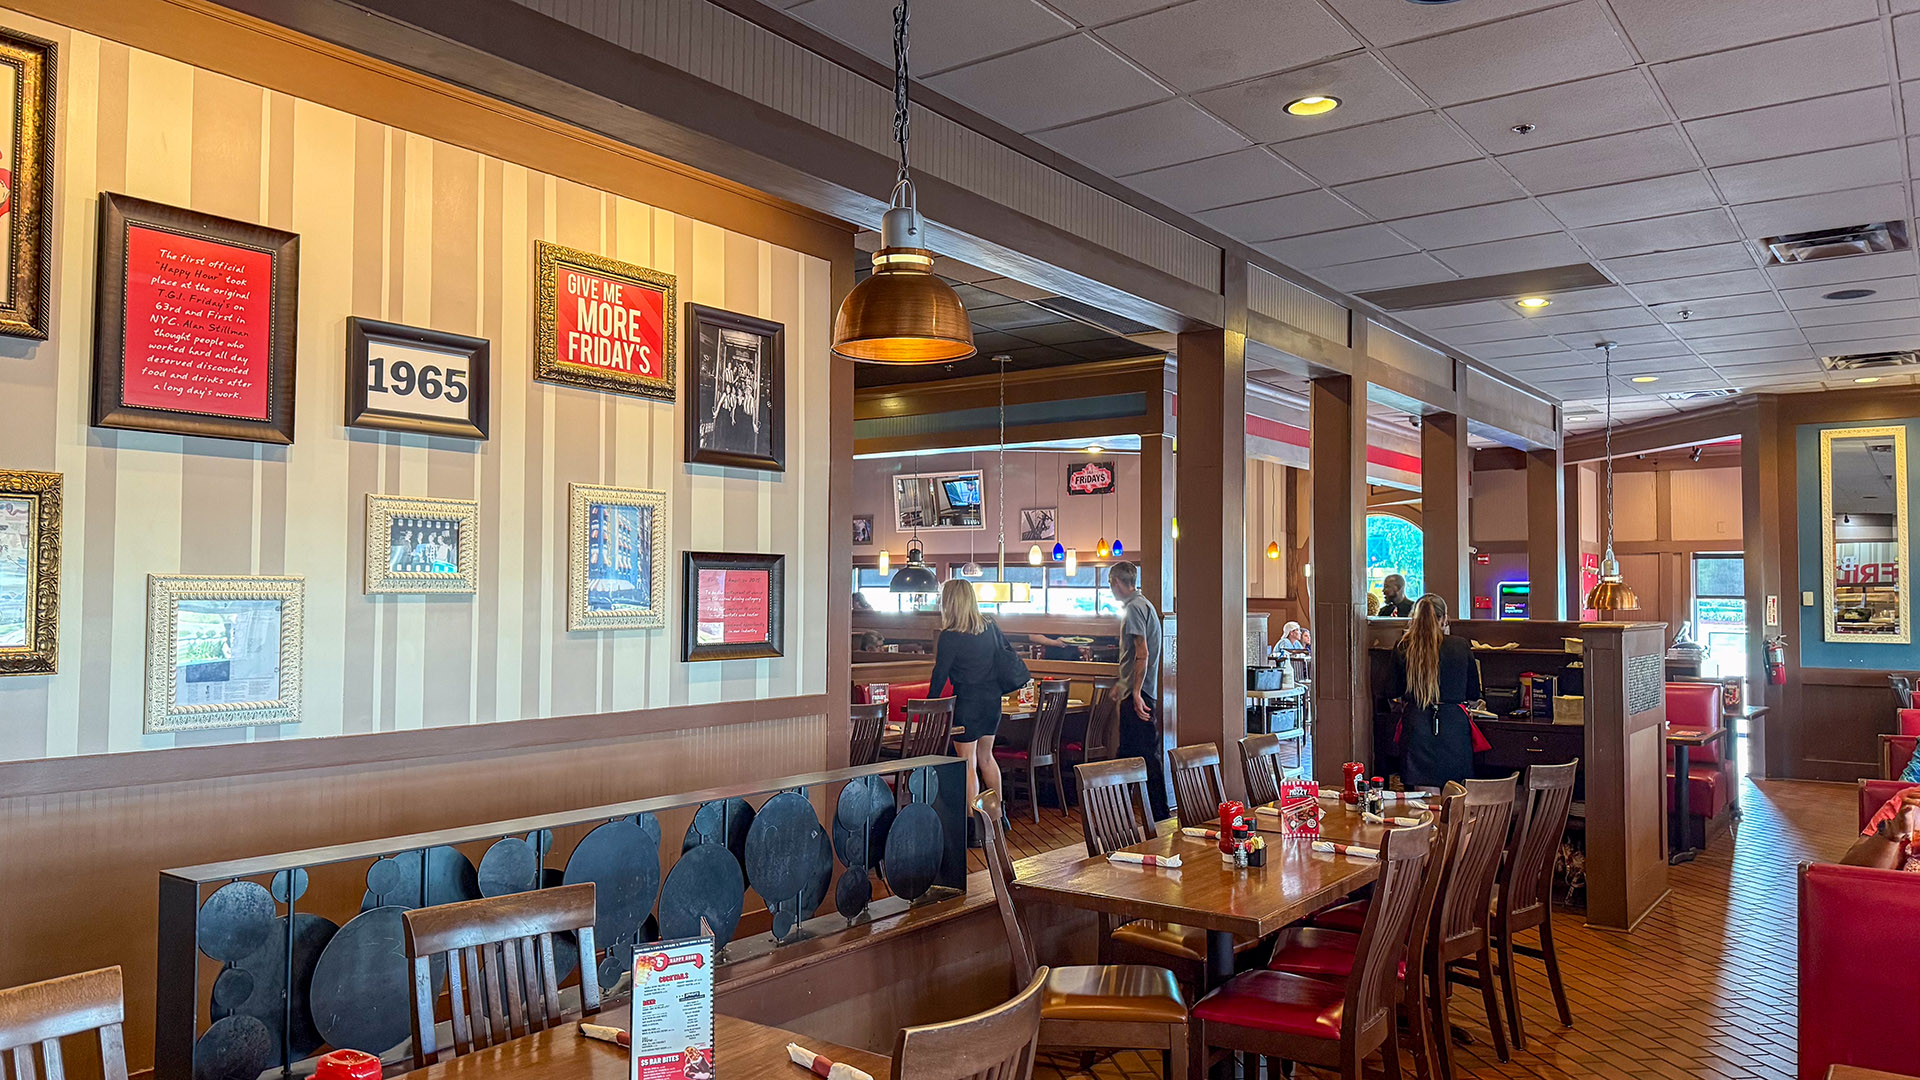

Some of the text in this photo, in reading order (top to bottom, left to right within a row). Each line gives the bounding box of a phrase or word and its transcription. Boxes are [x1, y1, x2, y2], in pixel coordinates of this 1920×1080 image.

[160, 249, 245, 273] The first official
[156, 261, 247, 286] "Happy Hour" took
[151, 276, 250, 300] place at the original
[158, 288, 185, 300] T.G.I.
[189, 295, 230, 310] Friday's
[568, 274, 623, 305] GIVE ME
[155, 302, 245, 324] 63rd and First in
[578, 297, 641, 343] MORE
[150, 314, 249, 336] NYC. Alan Stillman
[154, 328, 244, 349] thought people who
[147, 355, 249, 375] deserved discounted
[149, 343, 248, 366] worked hard all day
[142, 367, 166, 377] food
[192, 374, 224, 384] drinks
[227, 378, 252, 388] after
[369, 358, 468, 403] 1965
[163, 382, 184, 396] long
[187, 386, 212, 399] day's
[216, 391, 241, 399] work.
[659, 972, 689, 983] COCKTAILS
[641, 1055, 679, 1067] $5 BAR BITES
